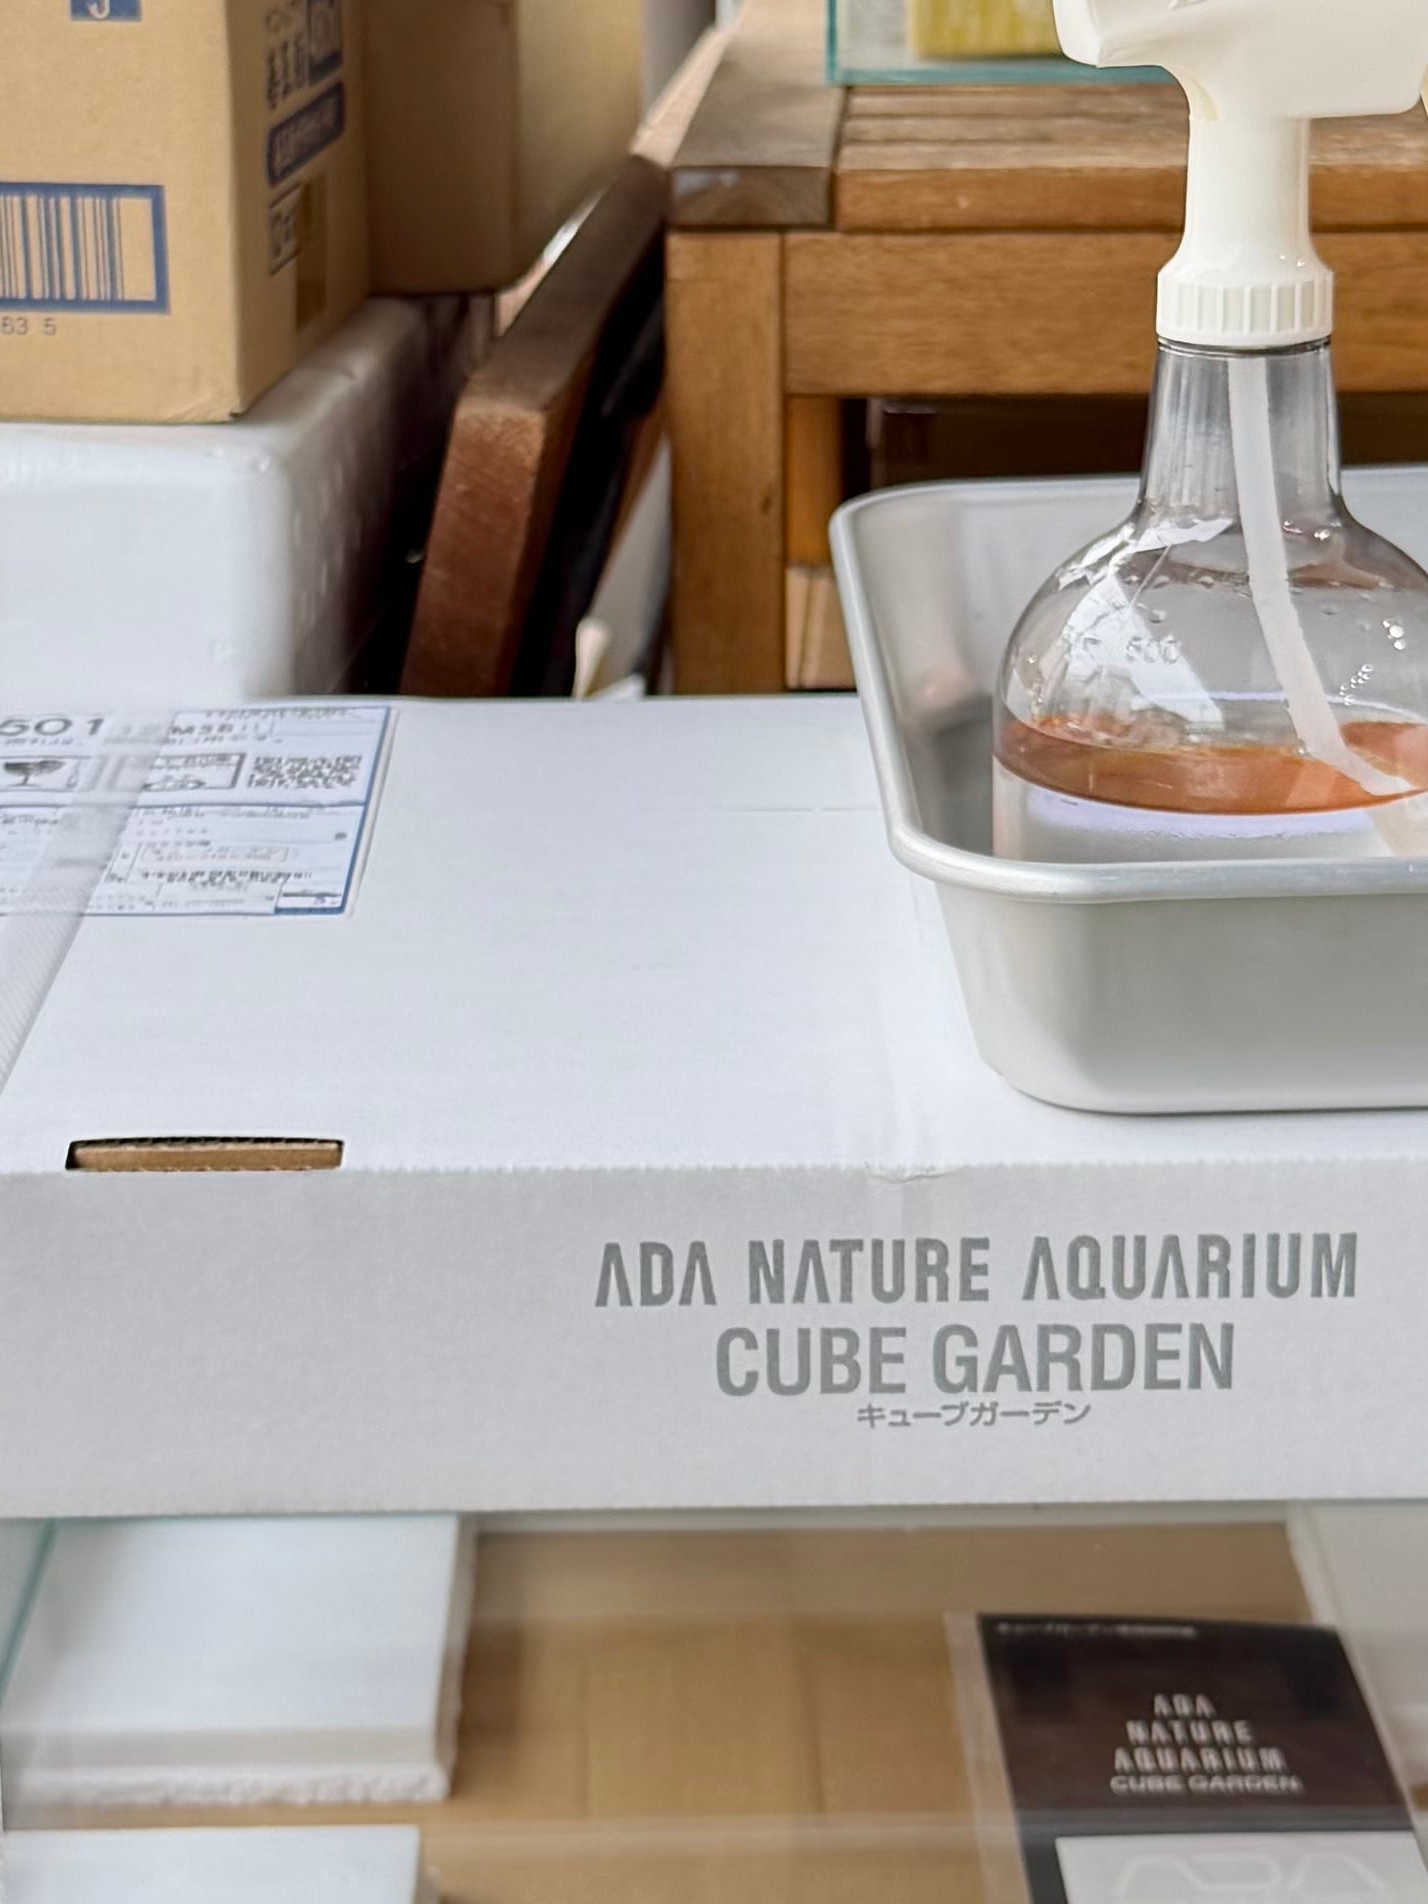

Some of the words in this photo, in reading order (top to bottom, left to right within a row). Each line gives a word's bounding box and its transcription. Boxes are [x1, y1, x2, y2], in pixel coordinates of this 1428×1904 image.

[594, 1240, 718, 1308] ADA
[748, 1237, 991, 1305] NATURE
[1022, 1232, 1358, 1301] AQUARIUM
[716, 1326, 908, 1398] CUBE
[932, 1322, 1236, 1394] GARDEN
[857, 1401, 1091, 1429] キューブガーデン
[1153, 1693, 1217, 1718] ADA
[1126, 1719, 1254, 1745] NATURE
[1114, 1746, 1286, 1774] AQUARIUM
[1110, 1775, 1184, 1795] CUBE
[1188, 1775, 1305, 1795] GARDEN
